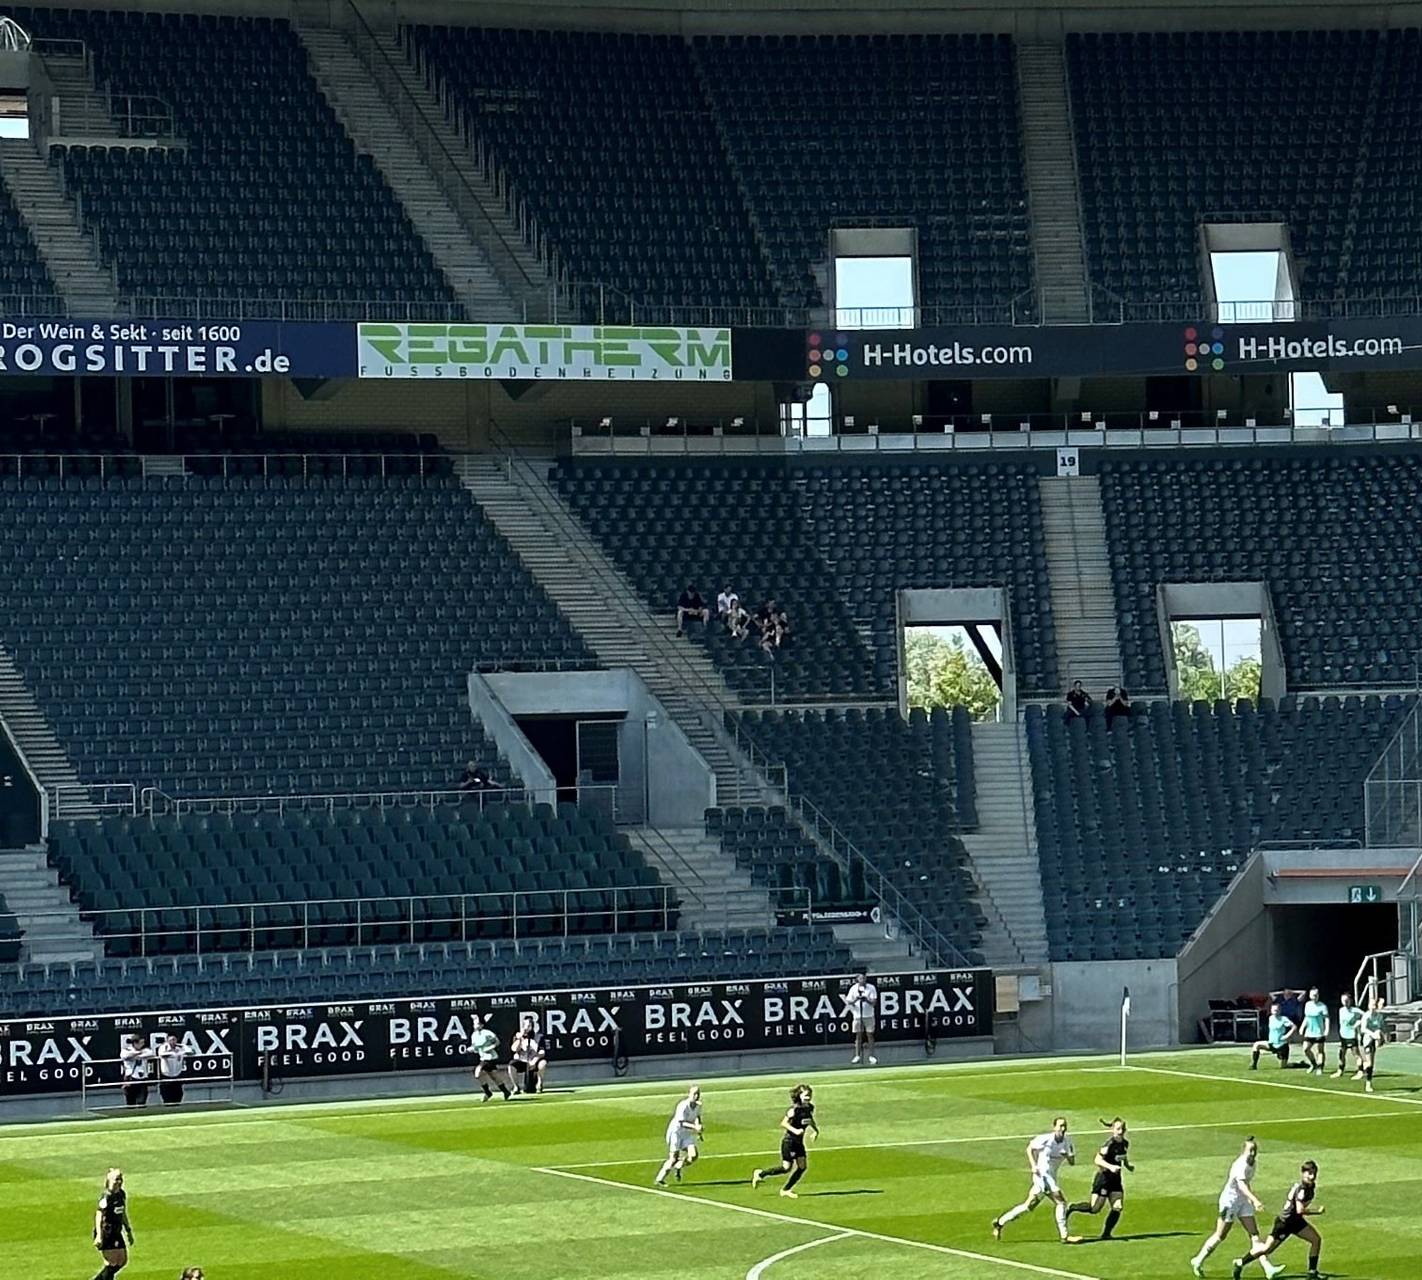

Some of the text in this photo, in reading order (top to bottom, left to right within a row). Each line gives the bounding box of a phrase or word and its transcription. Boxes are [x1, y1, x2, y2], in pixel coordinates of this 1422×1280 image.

[3, 323, 34, 339] Der
[39, 323, 85, 340] Wein
[91, 324, 105, 340] &
[110, 323, 147, 341] Sekt
[162, 325, 192, 342] seit
[199, 326, 241, 341] 1600
[359, 324, 730, 367] REGATHERM
[863, 341, 1033, 366] H-Hotels.com
[1238, 334, 1402, 359] H-Hotels.com
[1060, 456, 1076, 467] 19
[0, 1035, 92, 1067] RAX
[257, 1020, 364, 1051] BRAX
[645, 999, 744, 1030] BRAX
[880, 986, 975, 1016] BRAX
[764, 1021, 849, 1037] FEEL GOO
[880, 1018, 921, 1030] FEEL
[573, 1035, 609, 1049] GOO
[645, 1028, 745, 1045] FEEL GOOD
[257, 1050, 365, 1067] FEEL GOOD
[389, 1046, 434, 1059] FEEL
[39, 1067, 94, 1080] GOOD
